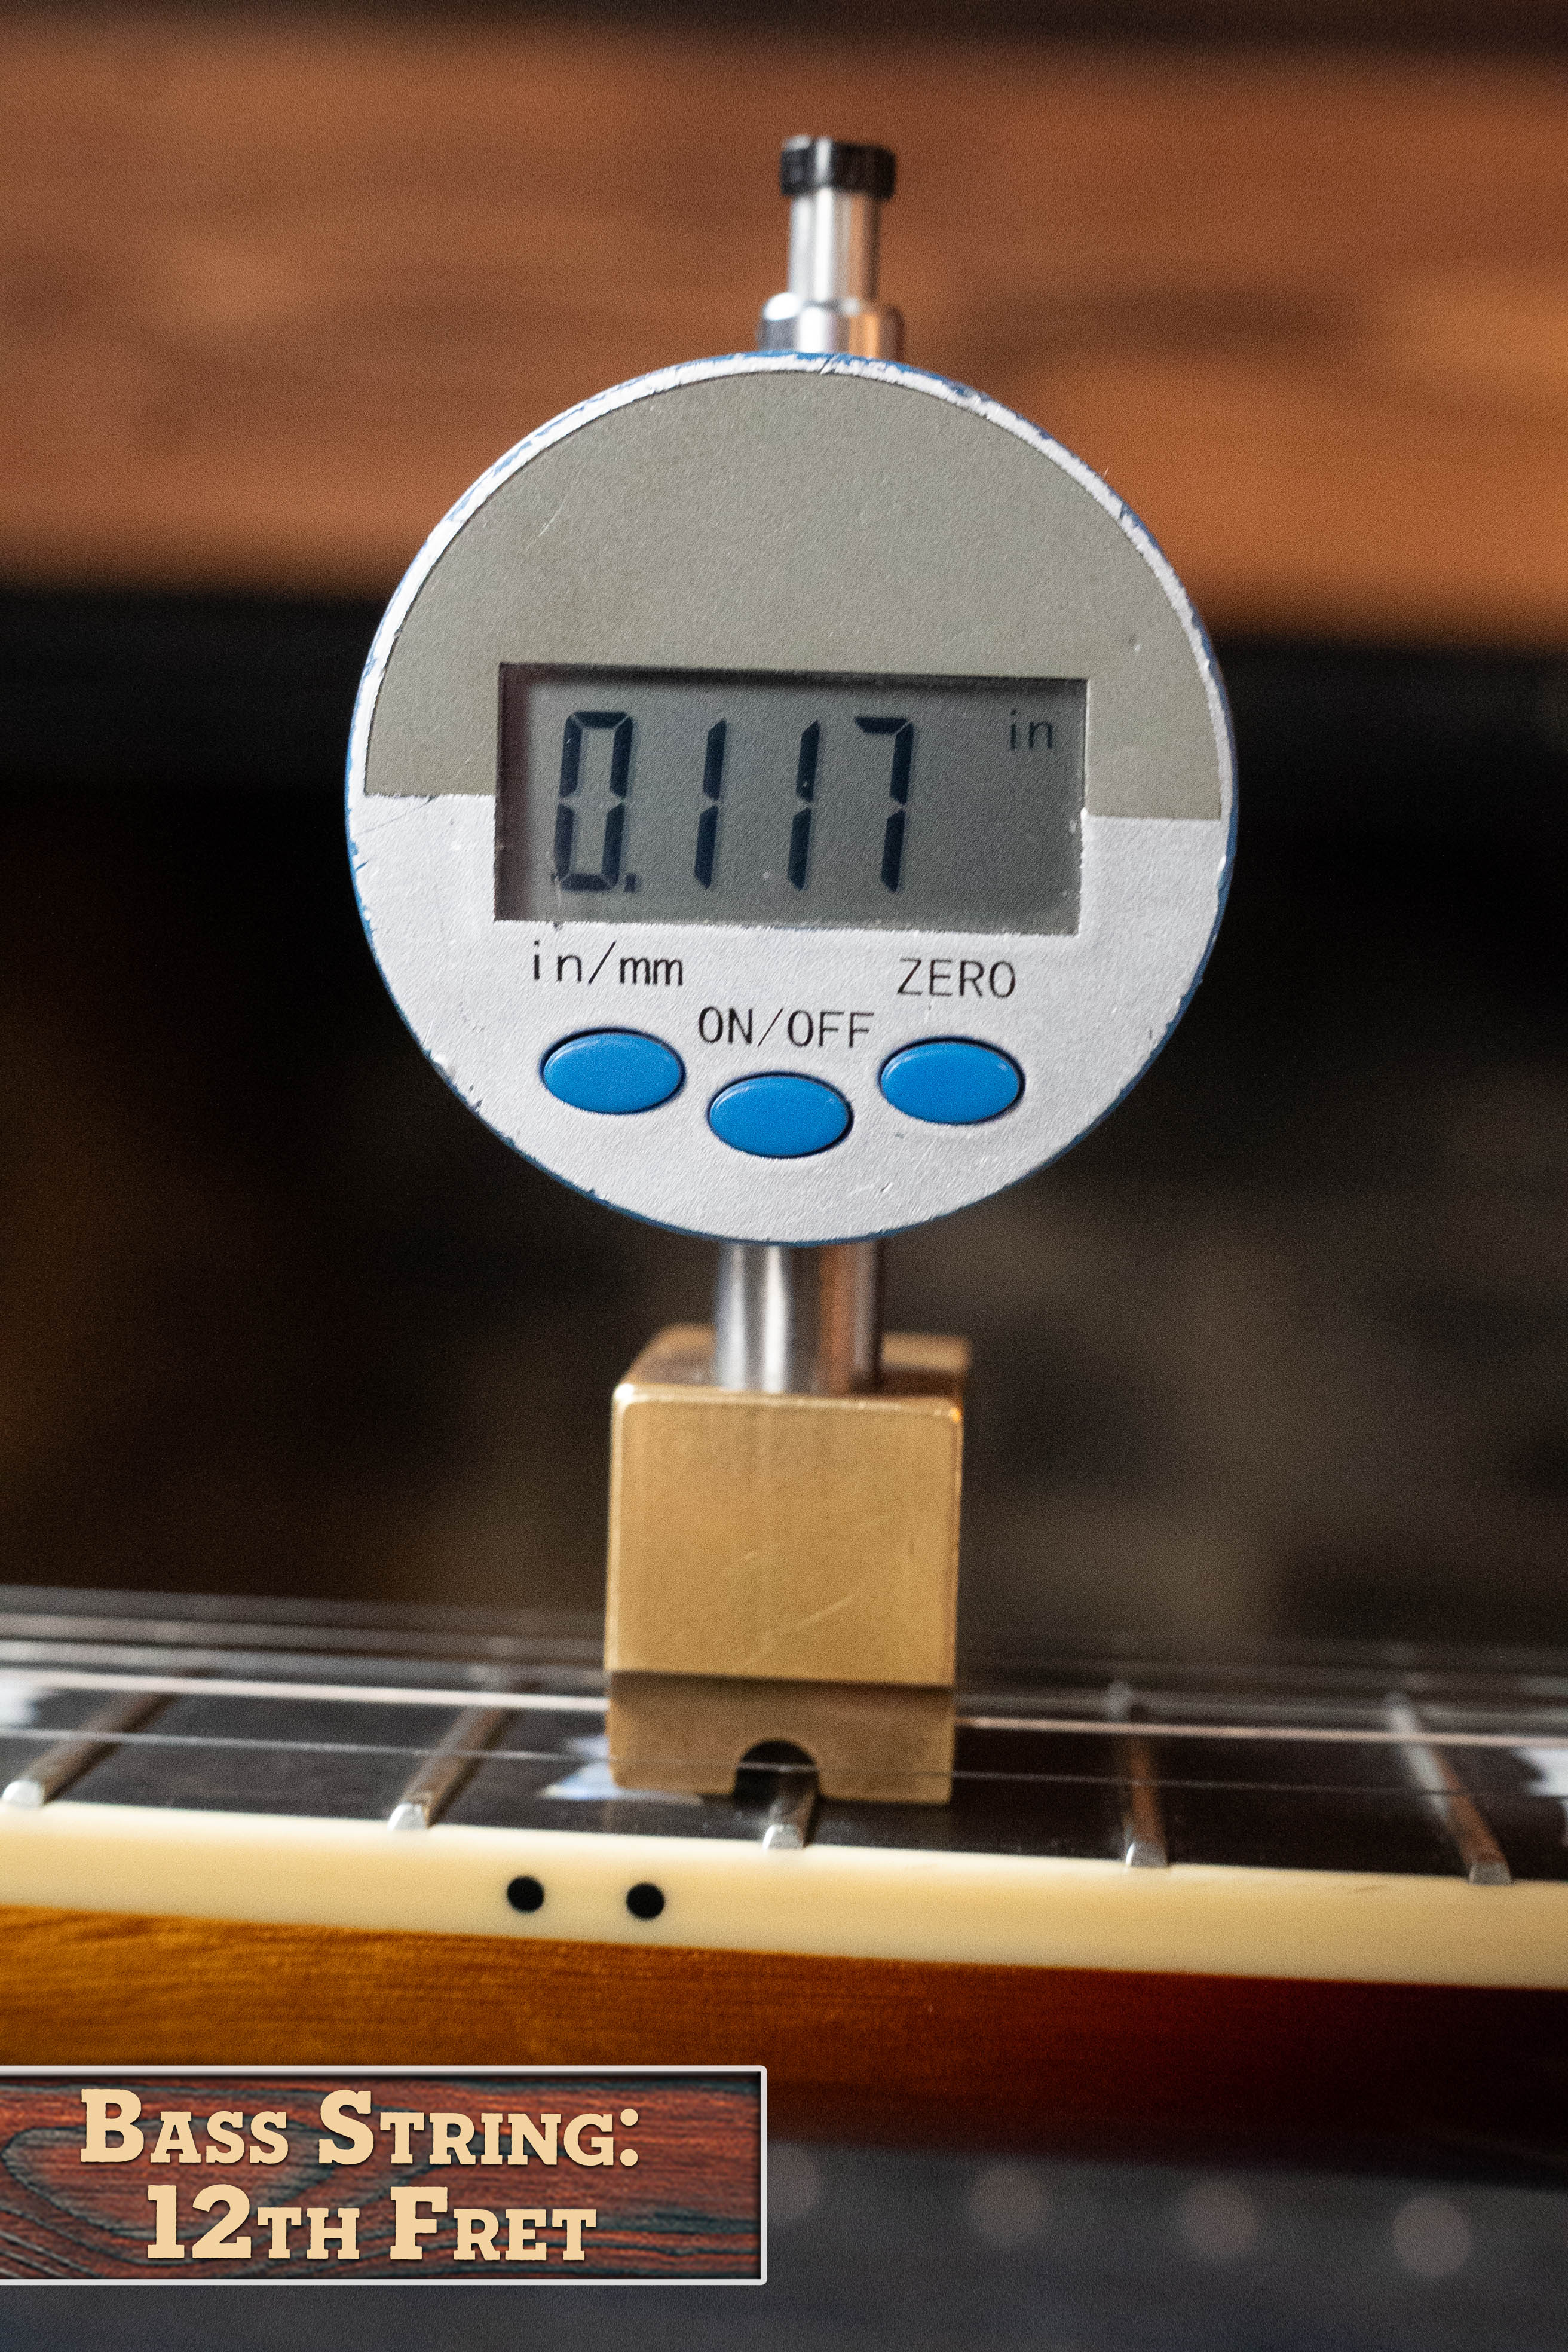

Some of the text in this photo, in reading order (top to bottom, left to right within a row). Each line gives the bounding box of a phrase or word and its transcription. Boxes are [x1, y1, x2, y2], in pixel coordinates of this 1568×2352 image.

[1008, 709, 1053, 751] in
[552, 710, 914, 893] 0.117
[532, 940, 684, 987] in/mm
[896, 957, 1017, 999] ZERO
[697, 1006, 875, 1048] ON/OFF
